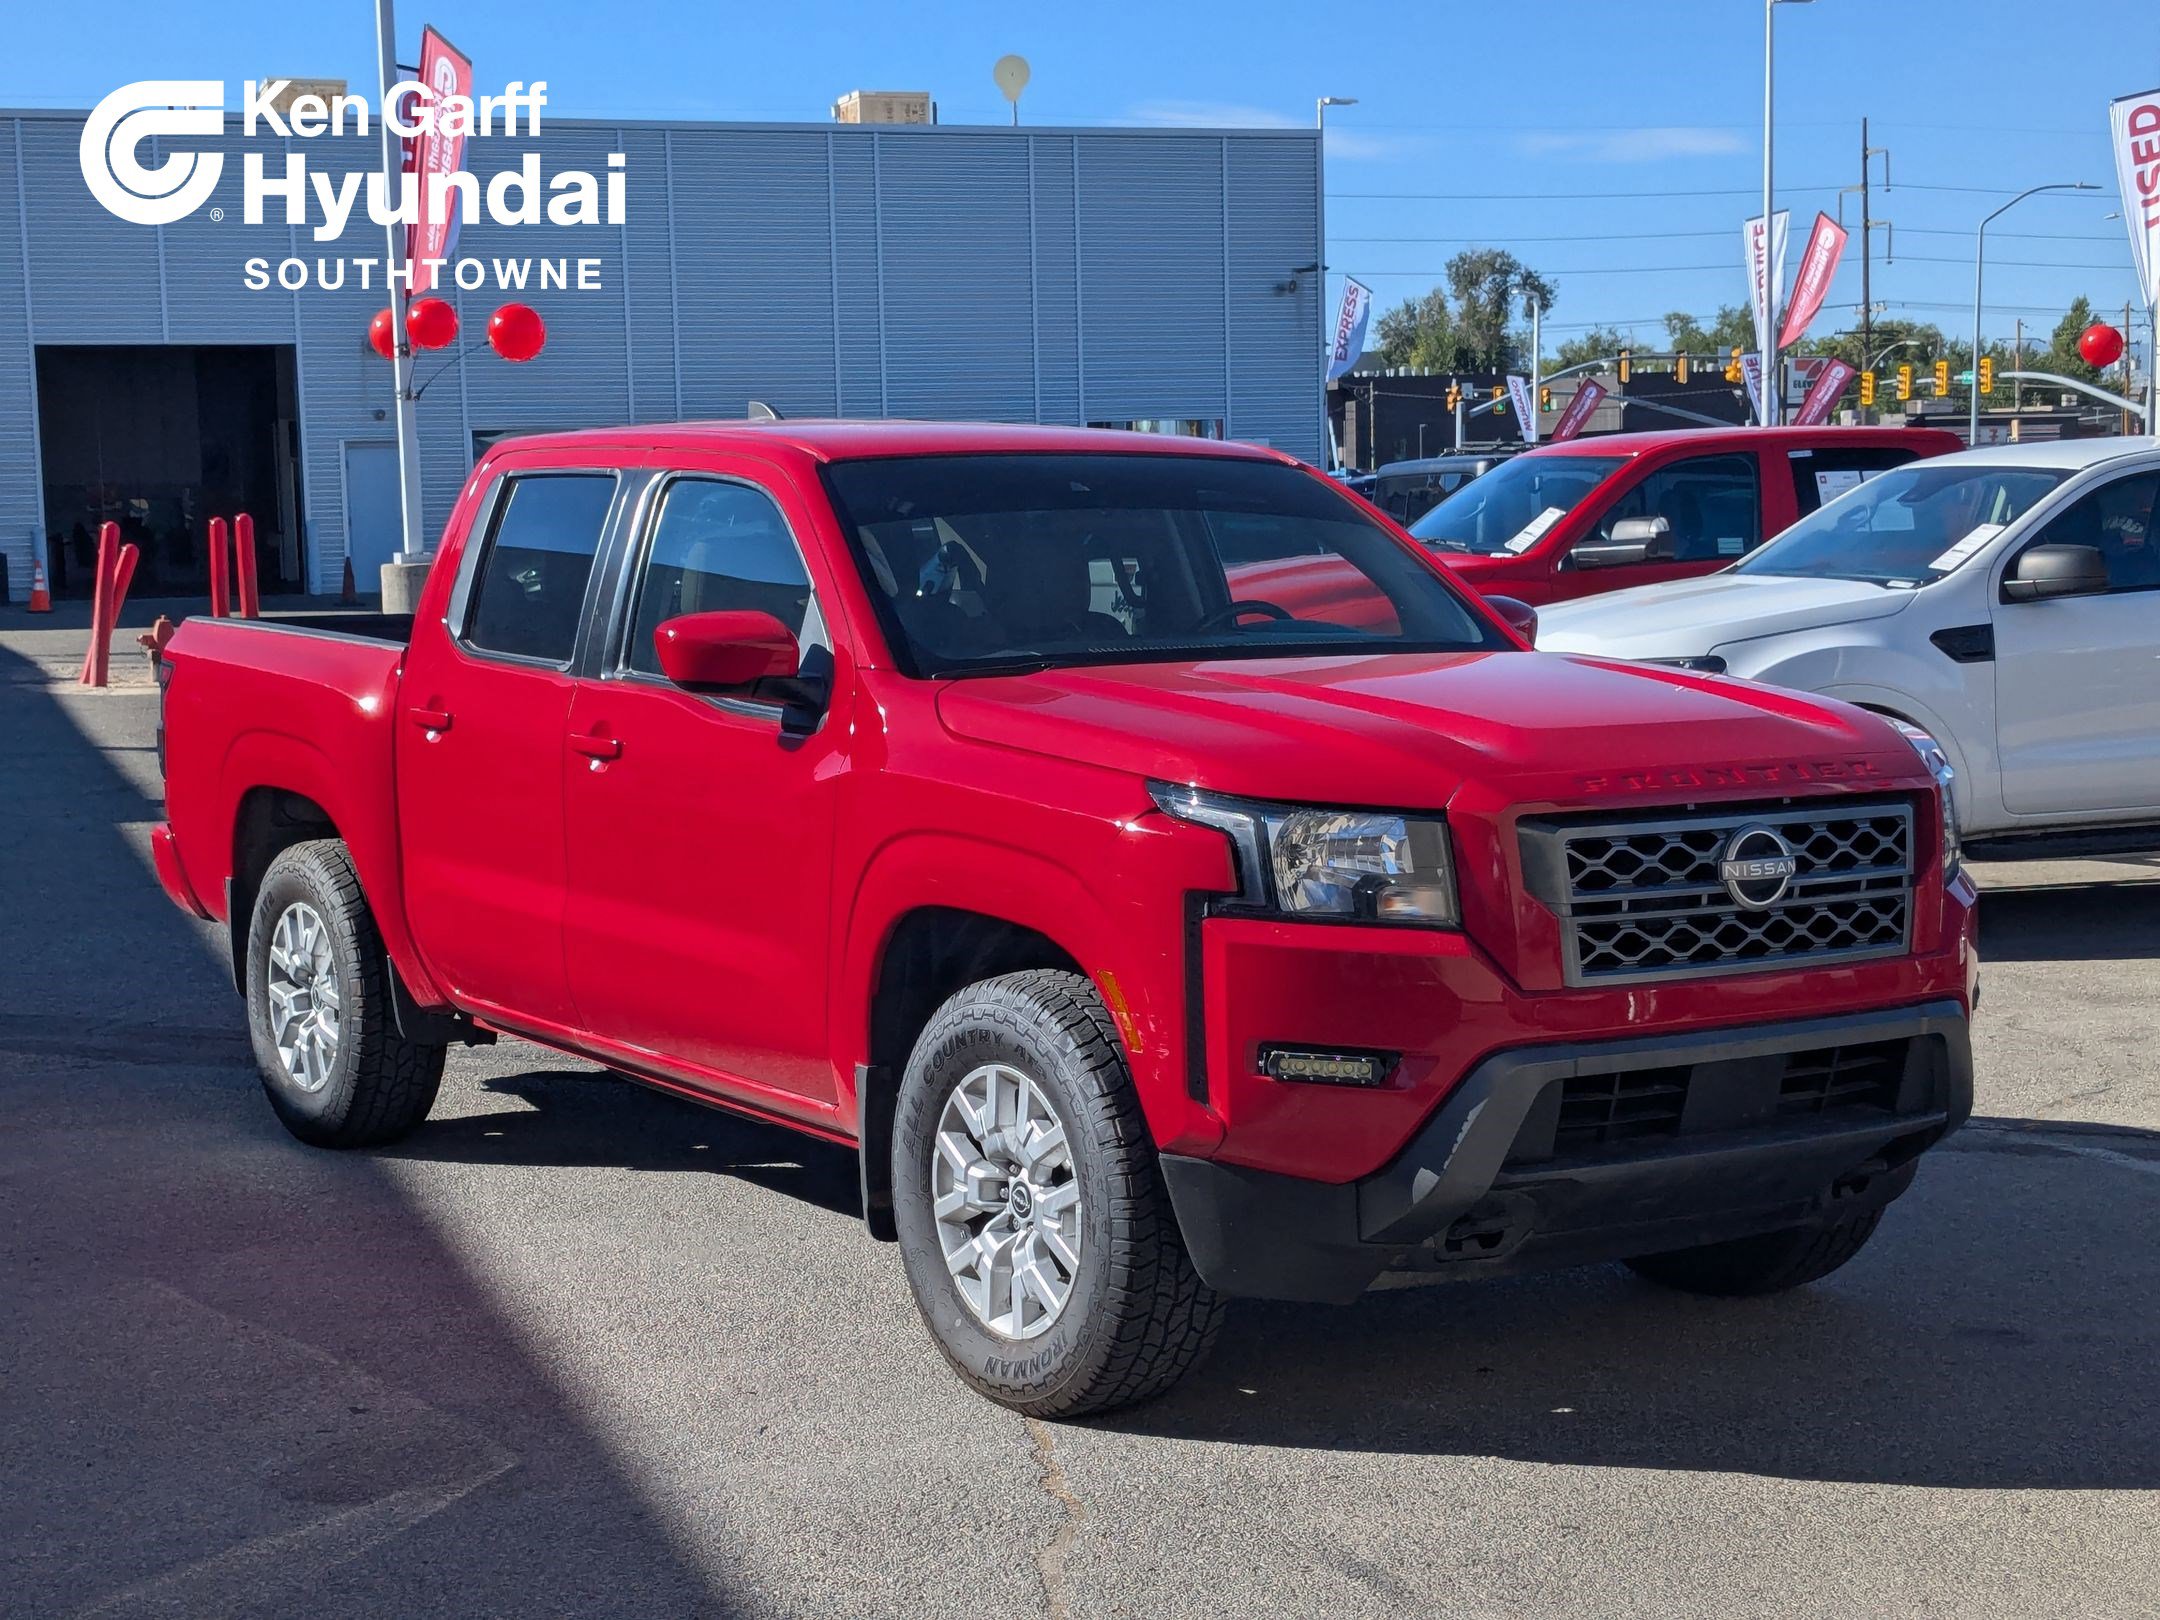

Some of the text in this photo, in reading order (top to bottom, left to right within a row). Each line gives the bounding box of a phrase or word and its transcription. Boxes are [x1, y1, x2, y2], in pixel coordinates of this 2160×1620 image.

[1334, 285, 1360, 362] EXPRESS
[1793, 380, 1814, 389] ELEV
[1577, 760, 1880, 793] FRONTIER
[1724, 860, 1796, 877] NISSAN
[923, 1029, 1006, 1088] COUNTRY
[983, 1327, 1068, 1379] IRONMAN
